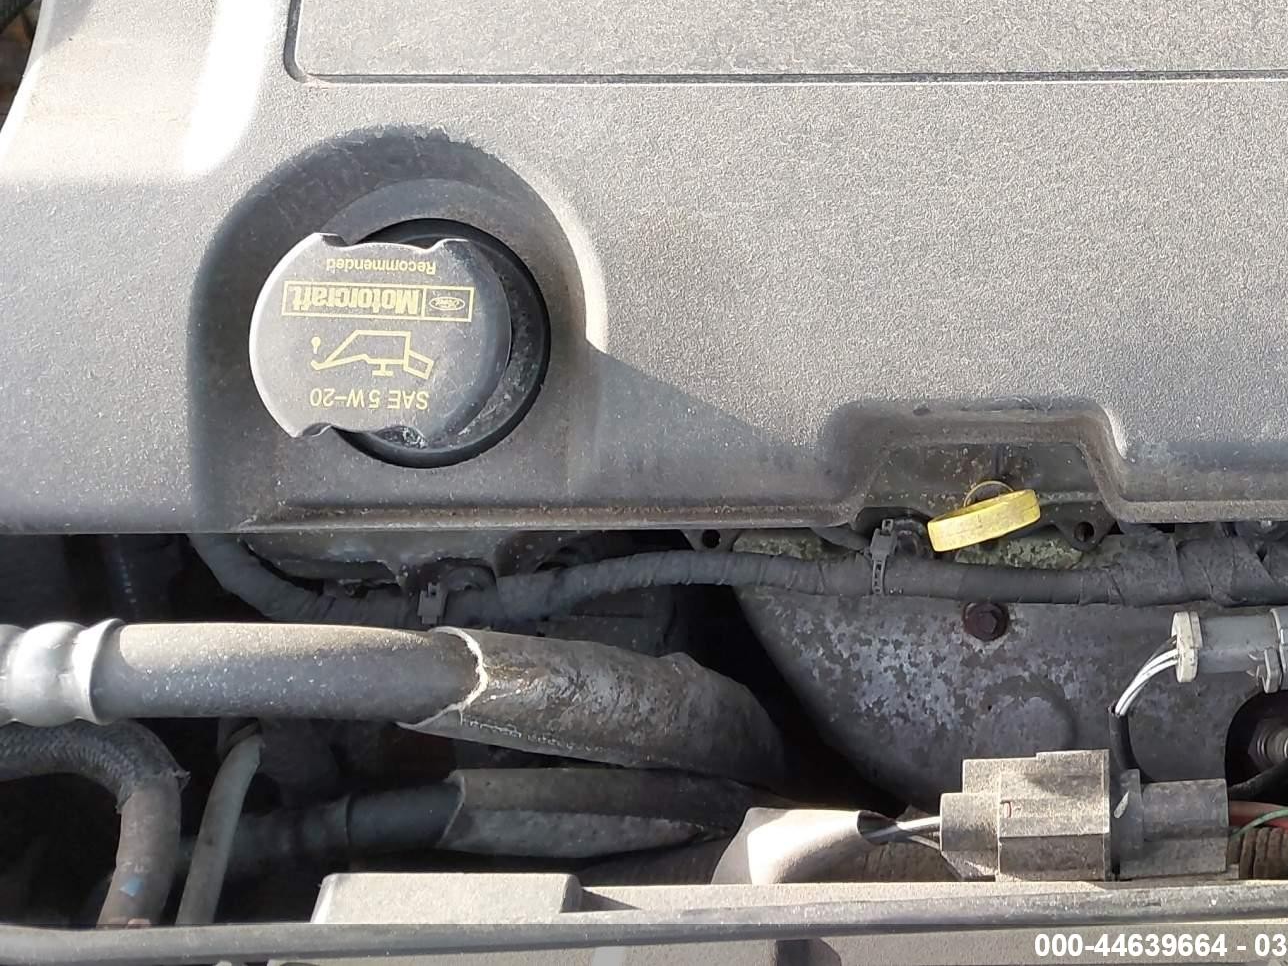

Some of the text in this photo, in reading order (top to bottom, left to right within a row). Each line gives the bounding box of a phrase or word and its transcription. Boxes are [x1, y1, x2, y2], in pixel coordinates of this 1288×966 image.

[326, 258, 437, 275] Recommended
[289, 285, 421, 315] Motorcraft
[388, 390, 430, 411] SAE
